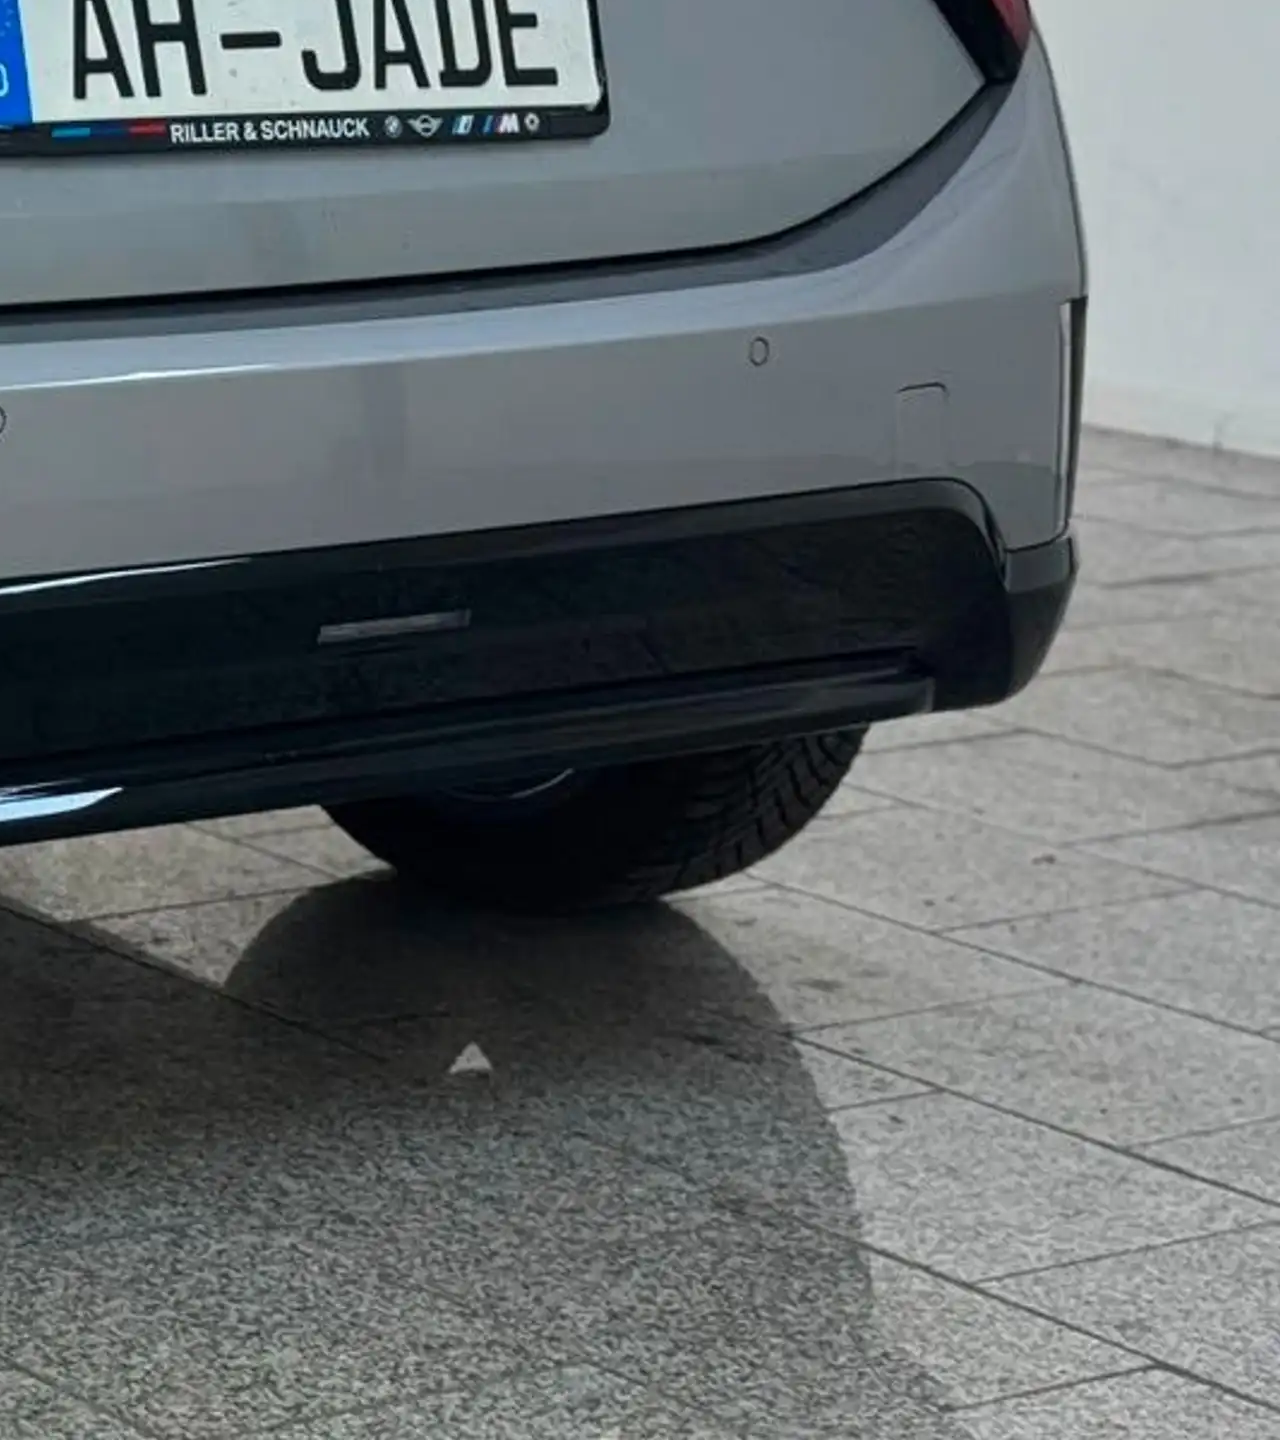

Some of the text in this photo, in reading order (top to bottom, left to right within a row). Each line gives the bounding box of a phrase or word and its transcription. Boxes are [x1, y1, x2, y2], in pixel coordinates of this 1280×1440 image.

[169, 121, 241, 144] RILLER
[242, 120, 259, 142] &
[259, 116, 371, 141] SCHNAUCK
